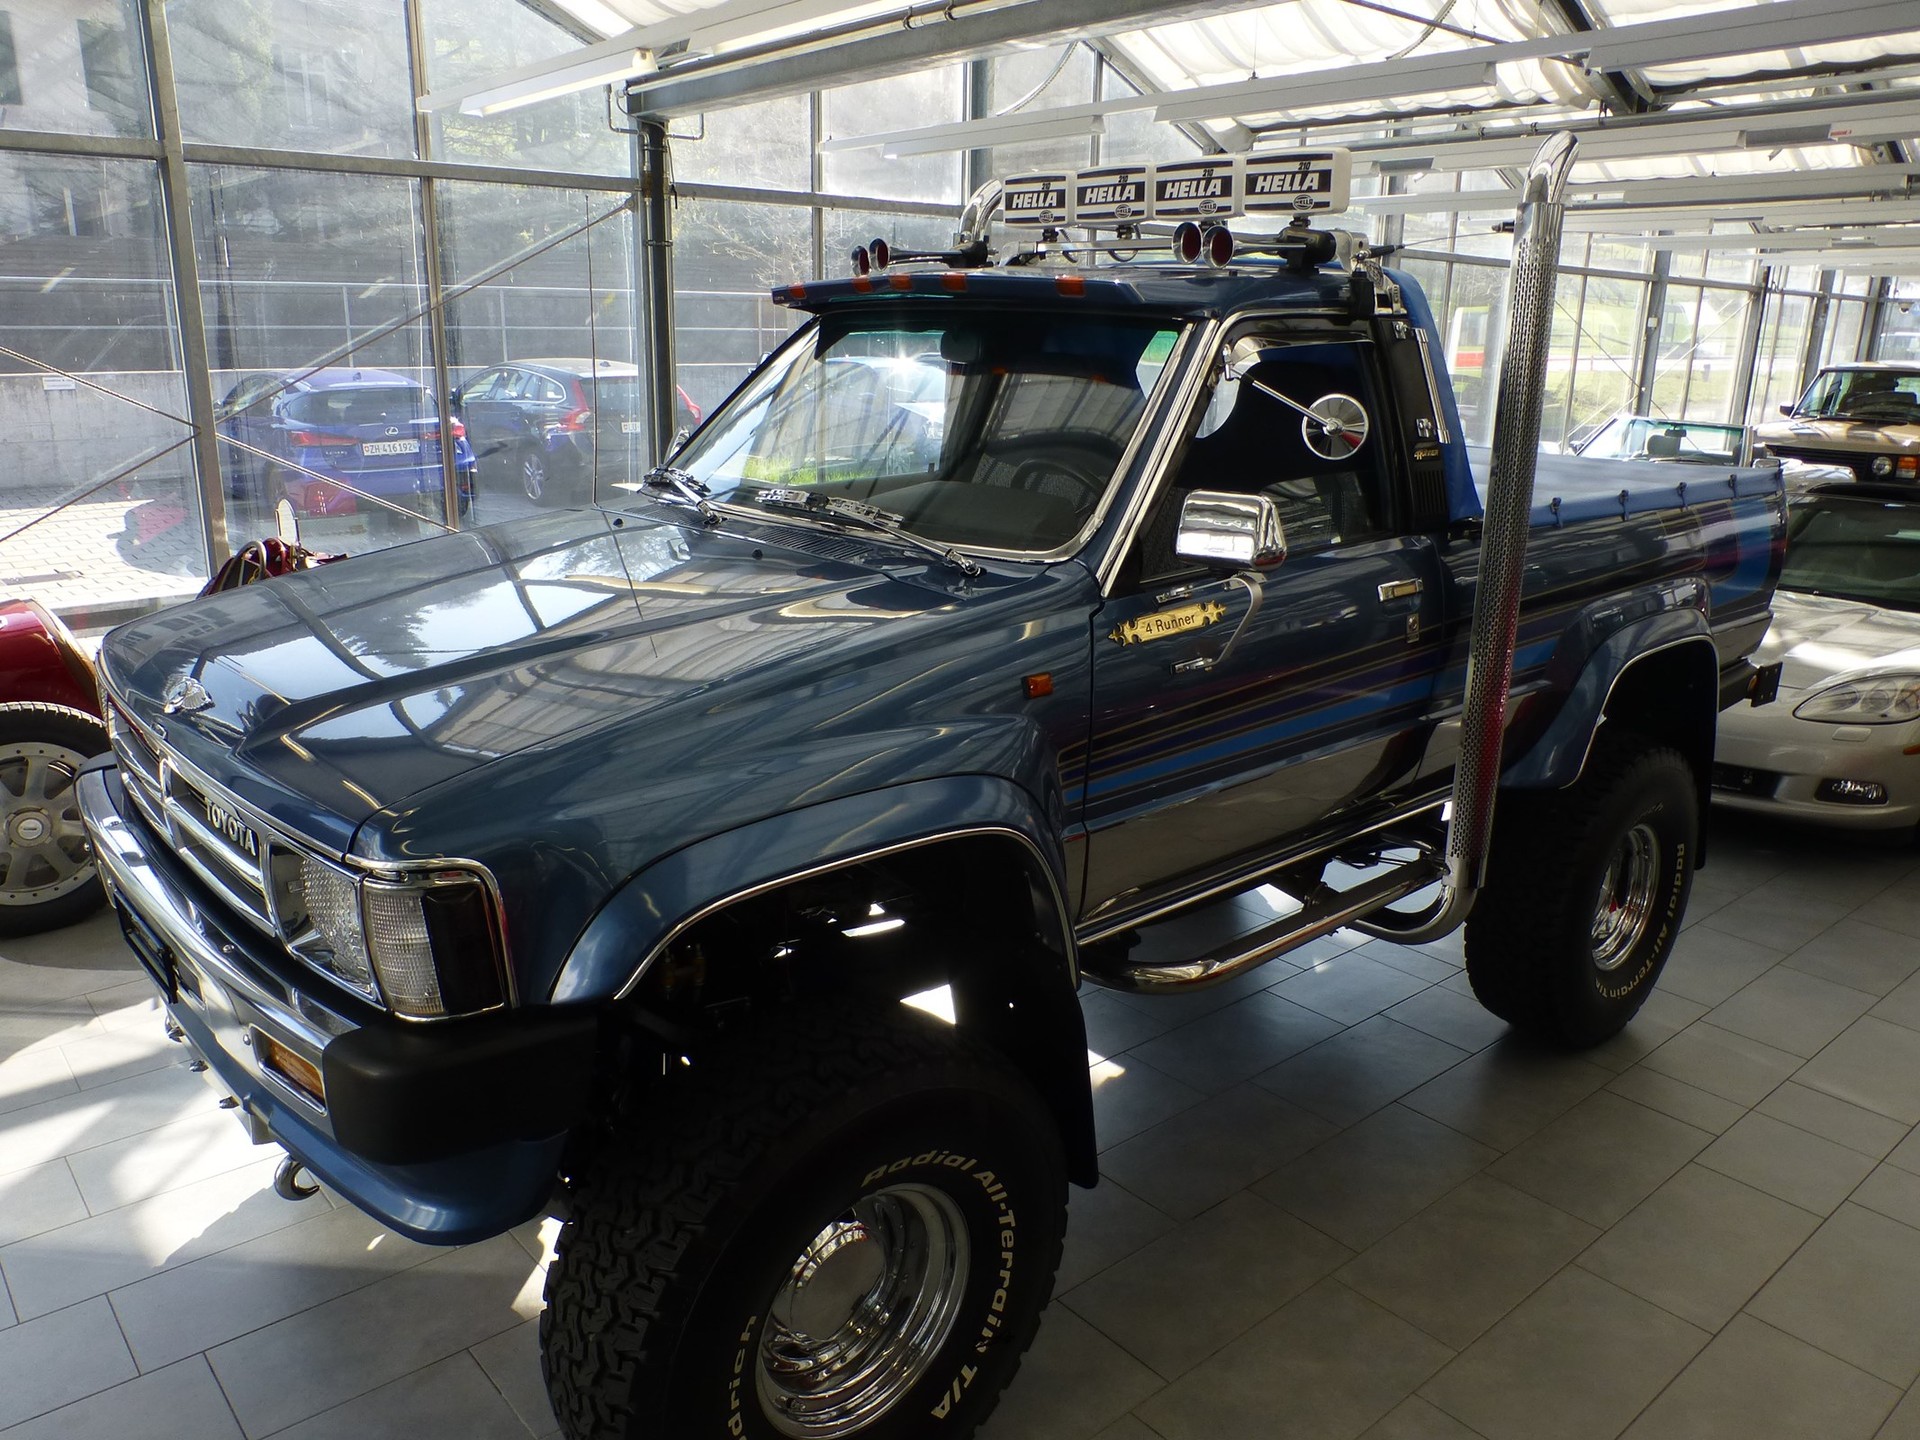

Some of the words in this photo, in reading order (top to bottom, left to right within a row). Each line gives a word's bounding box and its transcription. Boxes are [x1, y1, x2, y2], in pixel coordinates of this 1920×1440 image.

[1202, 169, 1214, 177] 210
[1298, 162, 1312, 171] 210
[1118, 175, 1129, 183] 210
[1164, 179, 1222, 199] HELLA
[1254, 172, 1320, 193] HELLA
[1012, 192, 1057, 209] HELLA
[1084, 185, 1136, 204] HELLA
[1145, 623, 1153, 634] 4
[1155, 614, 1196, 633] Runner
[204, 796, 257, 857] TOYOTA
[1667, 843, 1686, 919] Radial
[860, 1149, 978, 1188] Radial
[973, 1170, 1017, 1353] All-Terrain
[727, 1315, 757, 1440] drich
[931, 1364, 978, 1419] T/A
